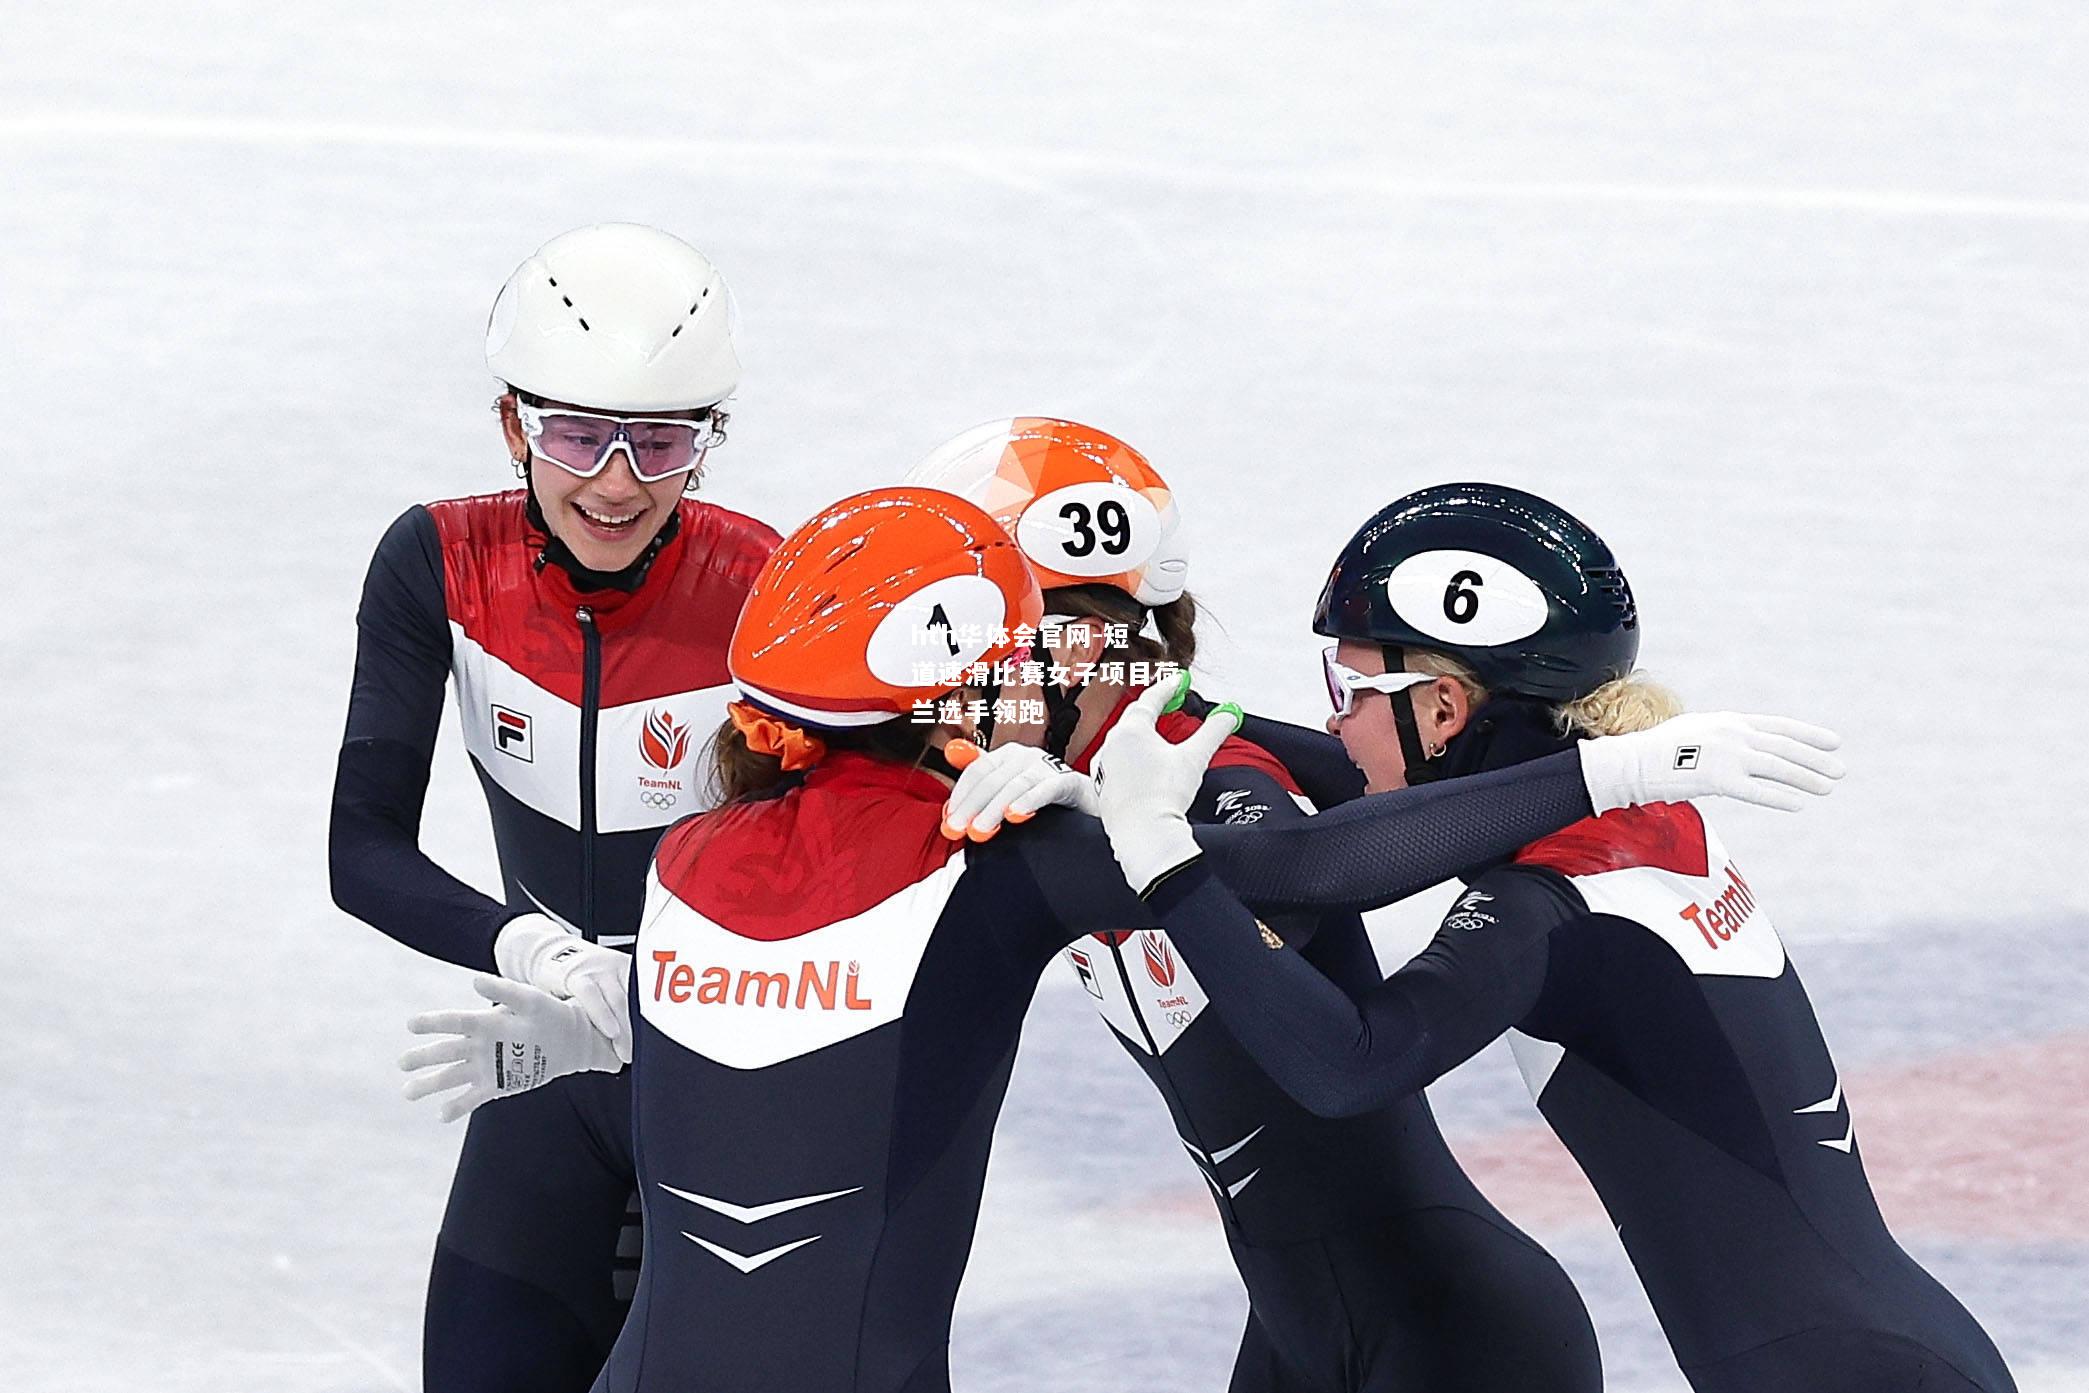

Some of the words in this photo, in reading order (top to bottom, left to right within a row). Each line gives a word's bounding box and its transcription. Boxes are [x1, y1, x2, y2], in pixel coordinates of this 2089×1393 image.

[1058, 500, 1131, 558] 39
[1443, 569, 1484, 625] 6
[638, 776, 682, 790] TeamNL
[652, 950, 872, 1010] TeamNL
